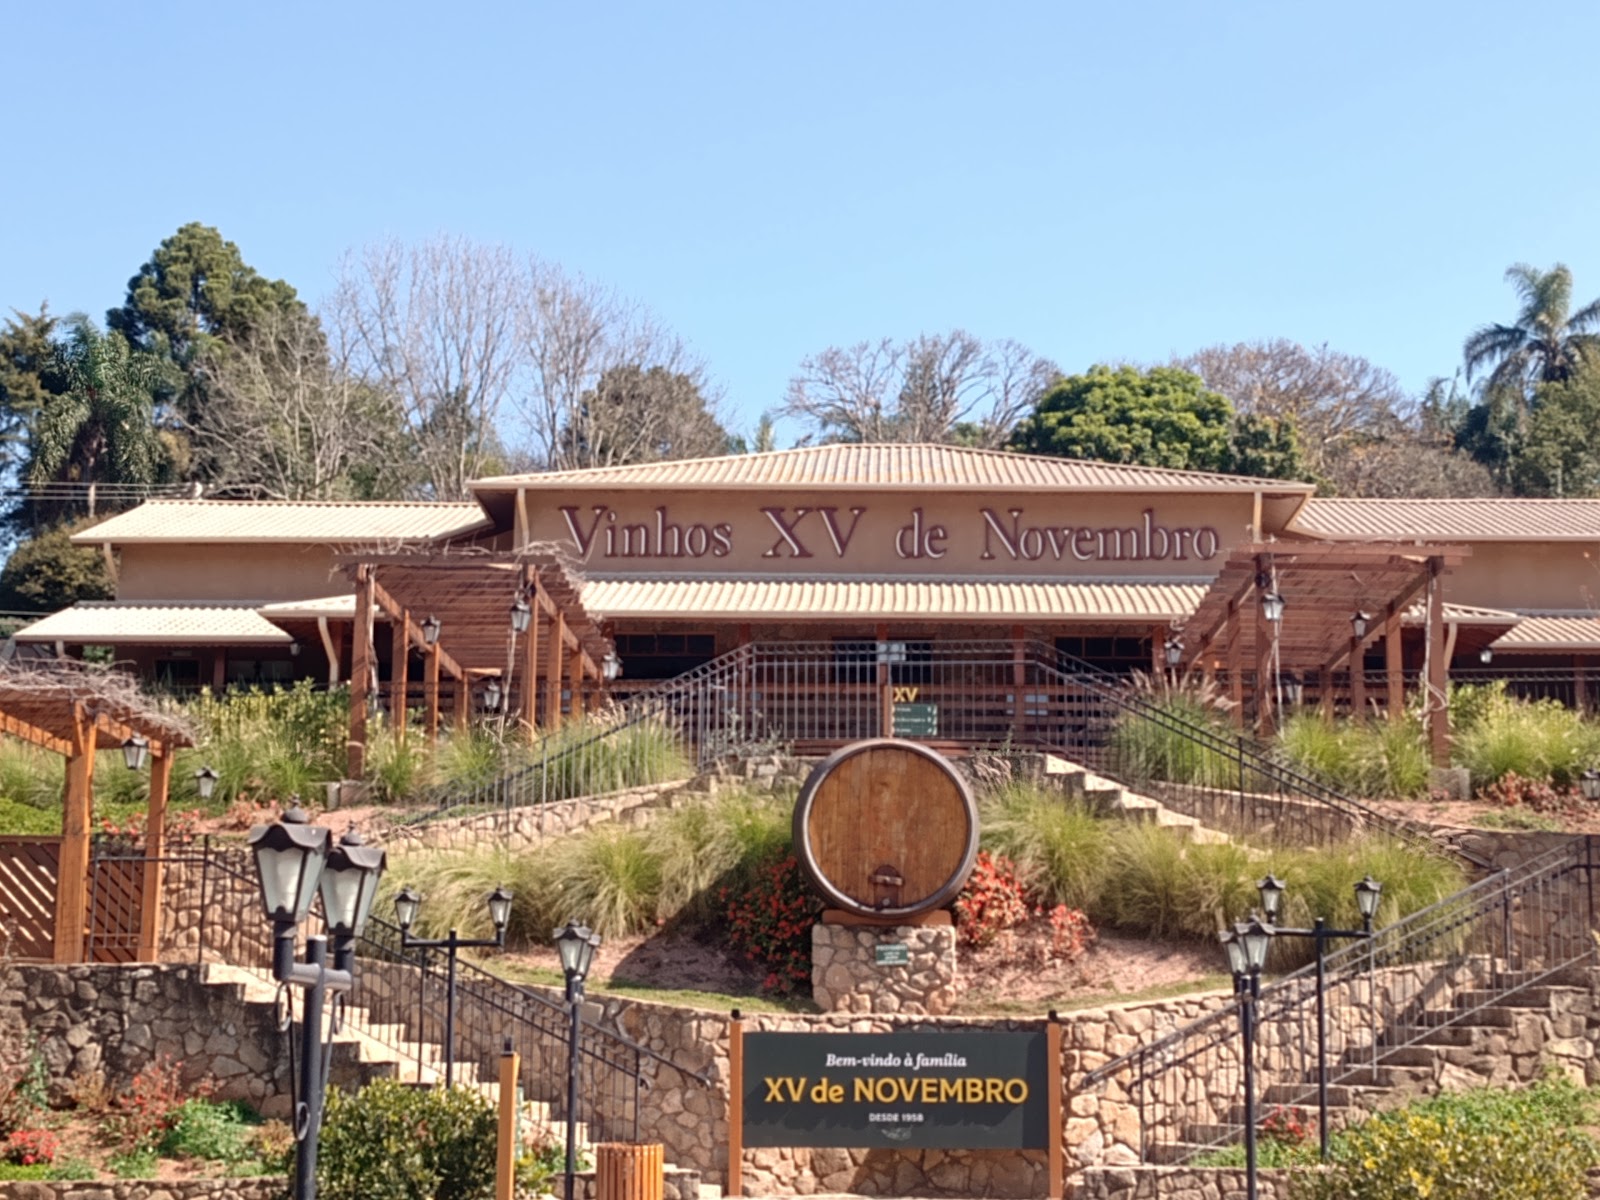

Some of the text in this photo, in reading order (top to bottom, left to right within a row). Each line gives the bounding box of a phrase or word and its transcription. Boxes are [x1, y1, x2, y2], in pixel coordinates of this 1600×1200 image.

[558, 505, 1220, 561] Vinhos XV de Novembro
[894, 687, 918, 702] XV
[825, 1052, 967, 1071] Bem-vindo à família
[764, 1077, 1029, 1104] XV de NOVEMBRO
[868, 1112, 924, 1122] DESDE 1958
